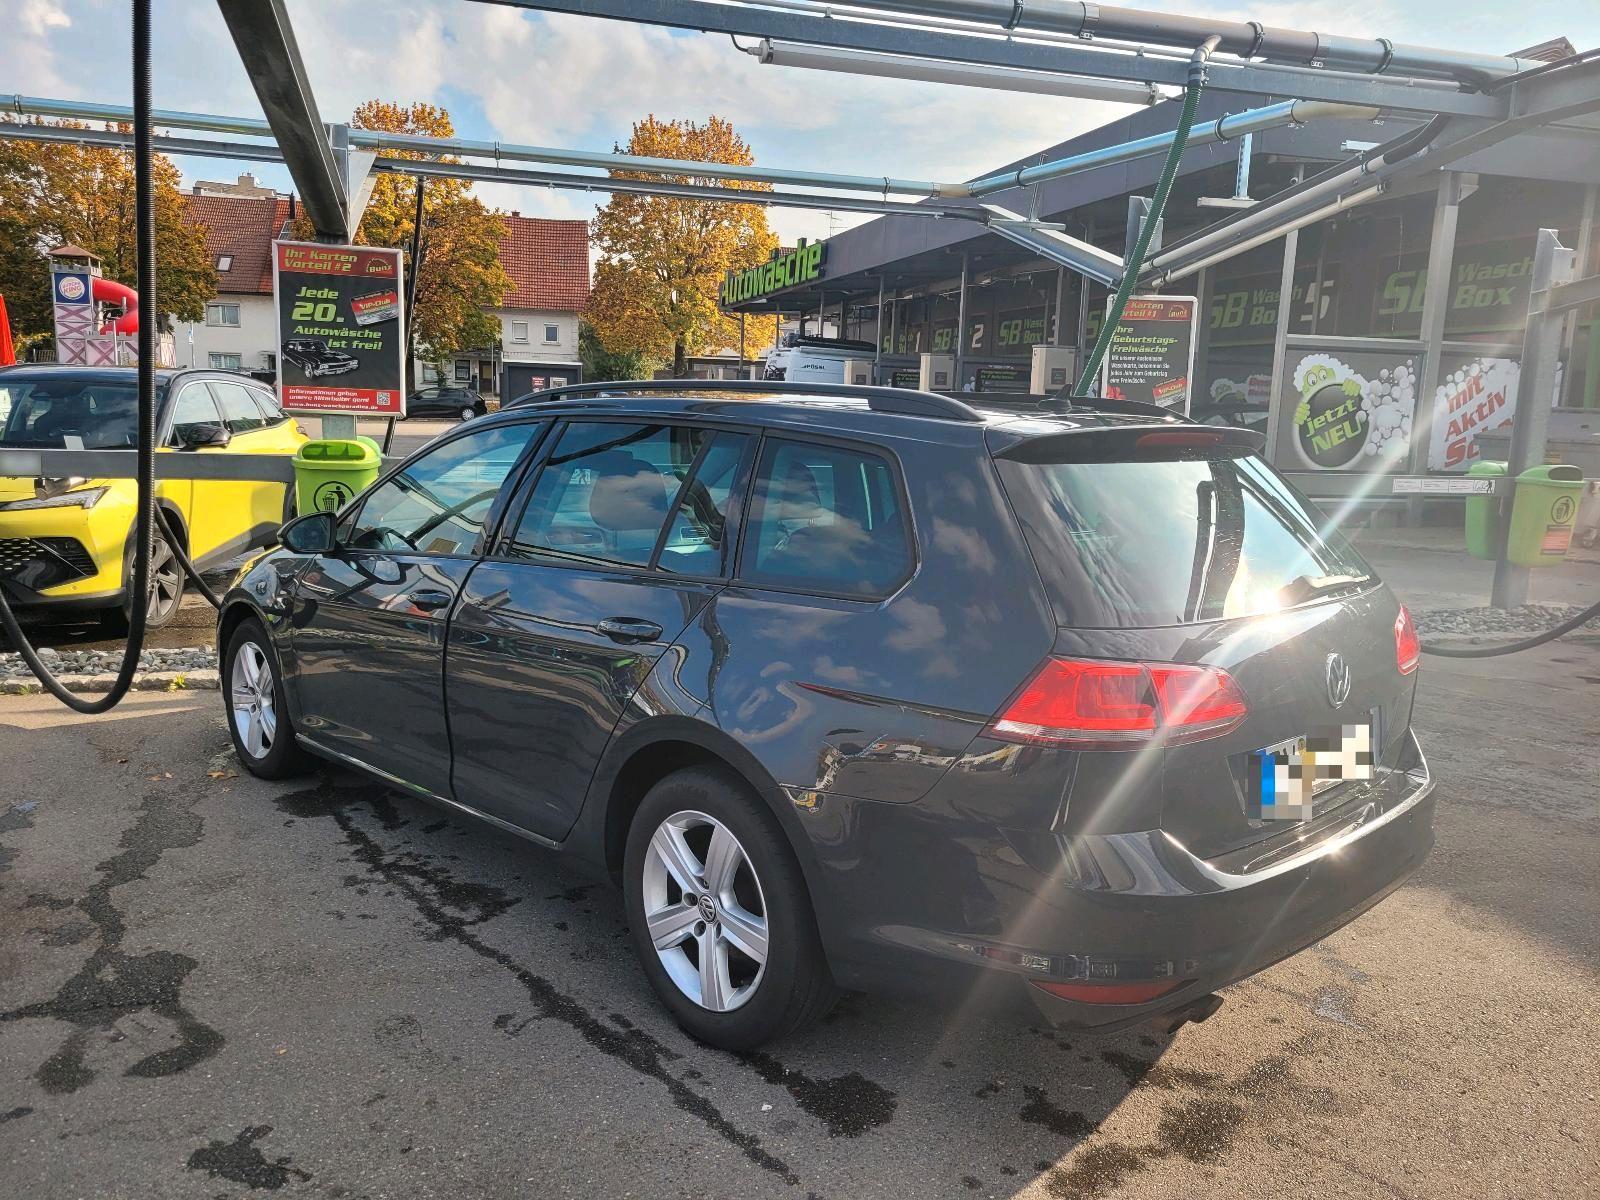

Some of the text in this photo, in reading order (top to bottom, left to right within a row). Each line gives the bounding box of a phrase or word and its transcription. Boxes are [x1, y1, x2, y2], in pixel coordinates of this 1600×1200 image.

[284, 259, 352, 272] Vorteil #2
[286, 249, 358, 262] Ihr Karten
[721, 238, 825, 306] Autowäsche
[295, 286, 339, 299] Jede
[1300, 280, 1335, 321] 5
[1453, 284, 1516, 309] Box
[291, 301, 345, 323] 20.
[1249, 305, 1277, 325] Bo
[293, 325, 382, 339] Autowäsche
[971, 323, 984, 349] 2
[1112, 335, 1178, 345] Geburtstags-
[352, 340, 383, 350] frei!
[1111, 345, 1168, 353] Freiwäsche
[1447, 374, 1485, 414] mit
[1306, 399, 1357, 437] jetzt
[1445, 384, 1507, 442] Aktiv
[1312, 417, 1362, 455] NEU
